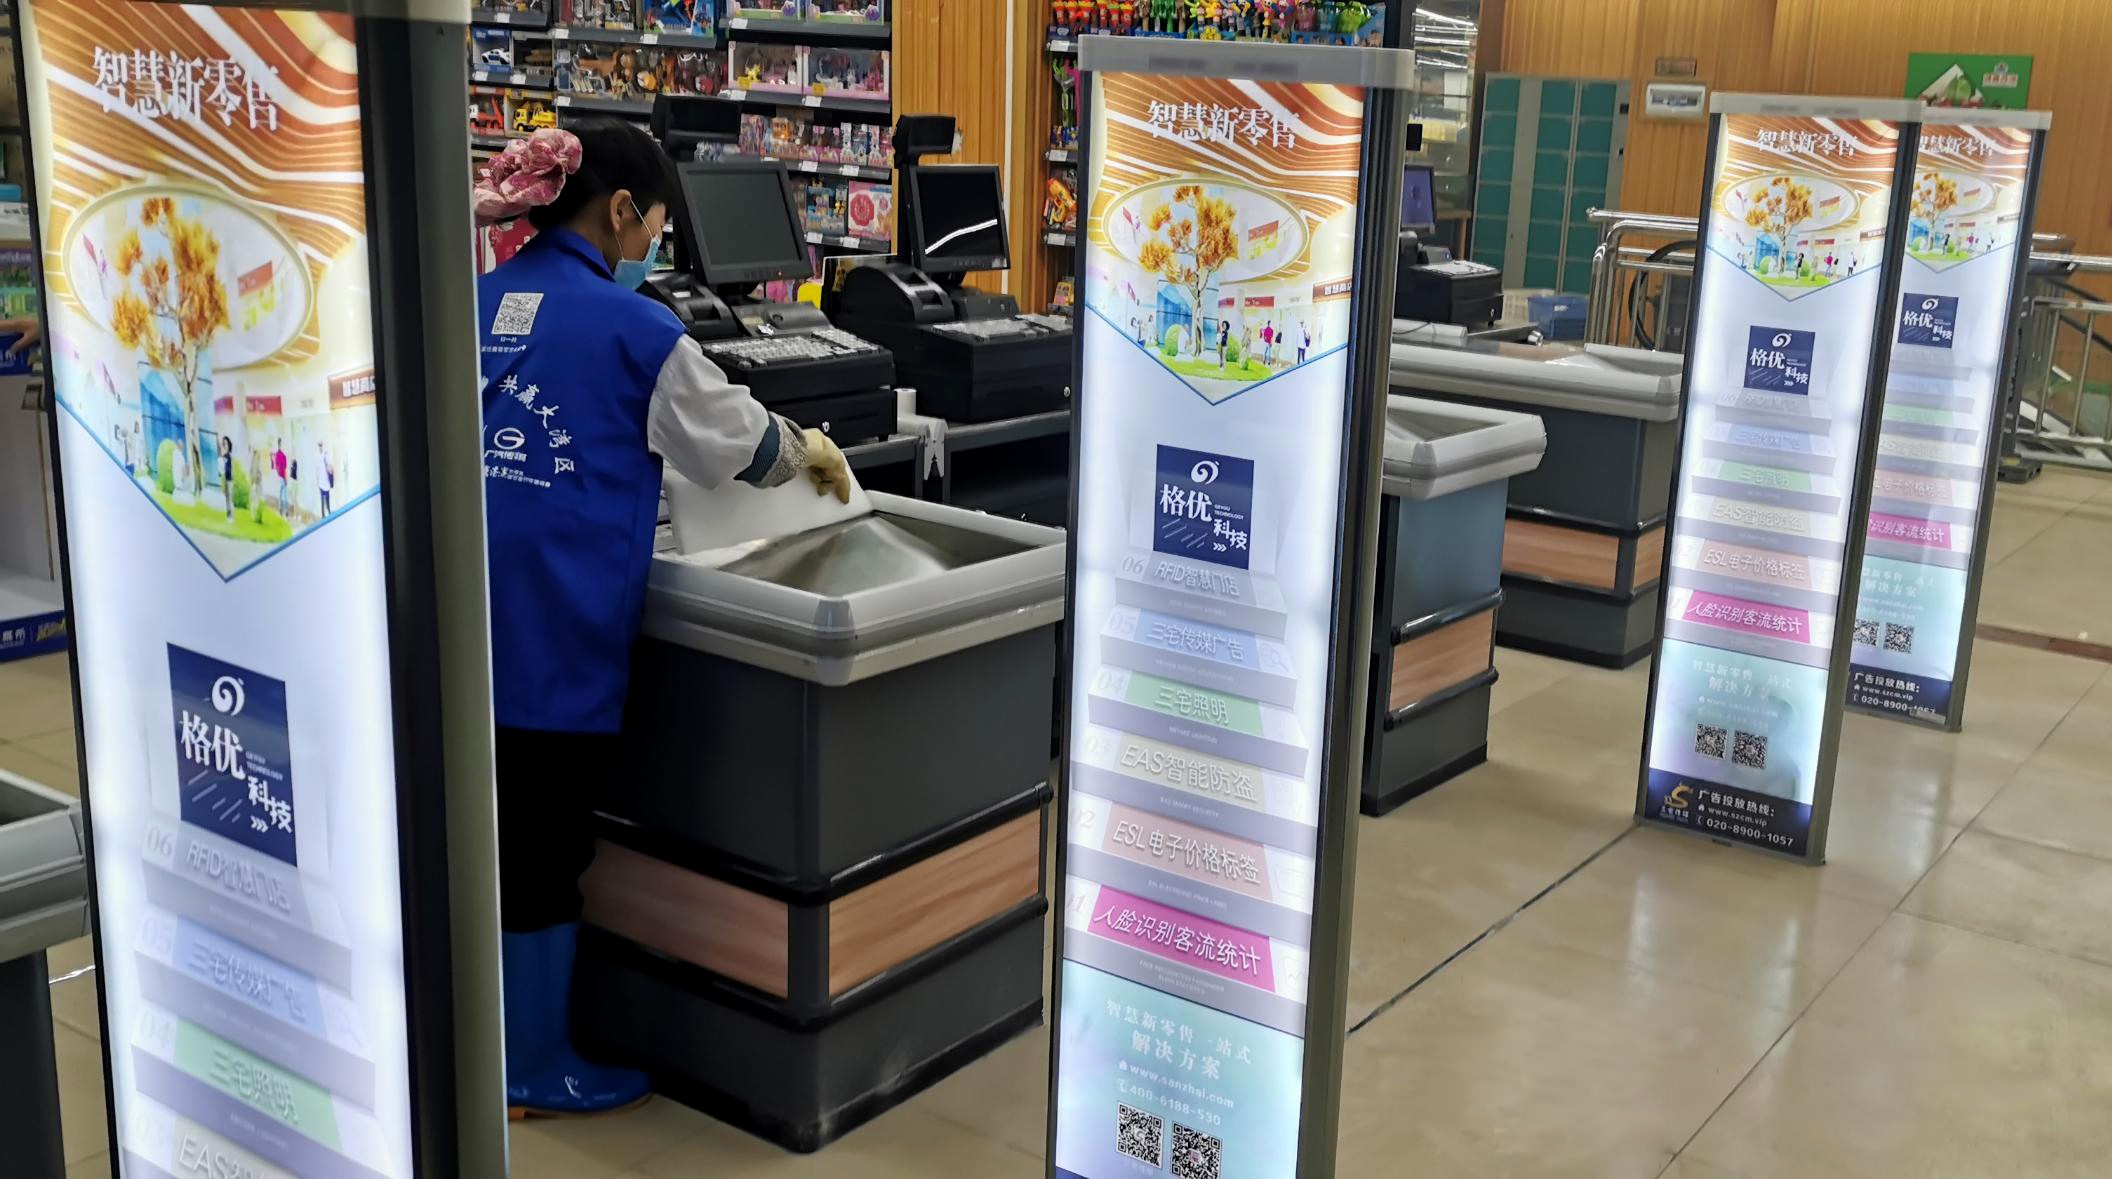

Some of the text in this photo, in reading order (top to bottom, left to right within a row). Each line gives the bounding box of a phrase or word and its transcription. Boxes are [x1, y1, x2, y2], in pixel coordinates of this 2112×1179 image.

[91, 45, 281, 132] 智慧新零售
[1146, 98, 1300, 149] 智慧新零售
[1756, 128, 1859, 157] 智慧新零售
[1902, 310, 1934, 328] 格优
[1932, 325, 1953, 340] 科技
[1749, 347, 1786, 369] 格优
[1784, 366, 1809, 384] 科技
[1160, 484, 1213, 522] 格优
[1213, 518, 1248, 551] 科技
[1122, 553, 1145, 576] 06
[1154, 560, 1240, 597] RFID智慧门店
[1686, 601, 1803, 635] 人脸识别客流统计
[1146, 621, 1245, 661] 三宅传媒广告
[1155, 685, 1230, 726] 三宅照明
[180, 710, 246, 780] 格优
[1120, 743, 1257, 803] EAS智能防盗
[247, 776, 293, 833] 科技
[146, 826, 174, 856] 06
[1706, 817, 1794, 847] 020-8900-1057
[1112, 820, 1262, 885] ESL电子价格标签
[1093, 904, 1262, 976] 人脸识别客流统计
[1131, 1029, 1222, 1080] 解决方案
[1129, 1083, 1222, 1127] 400-6188-530
